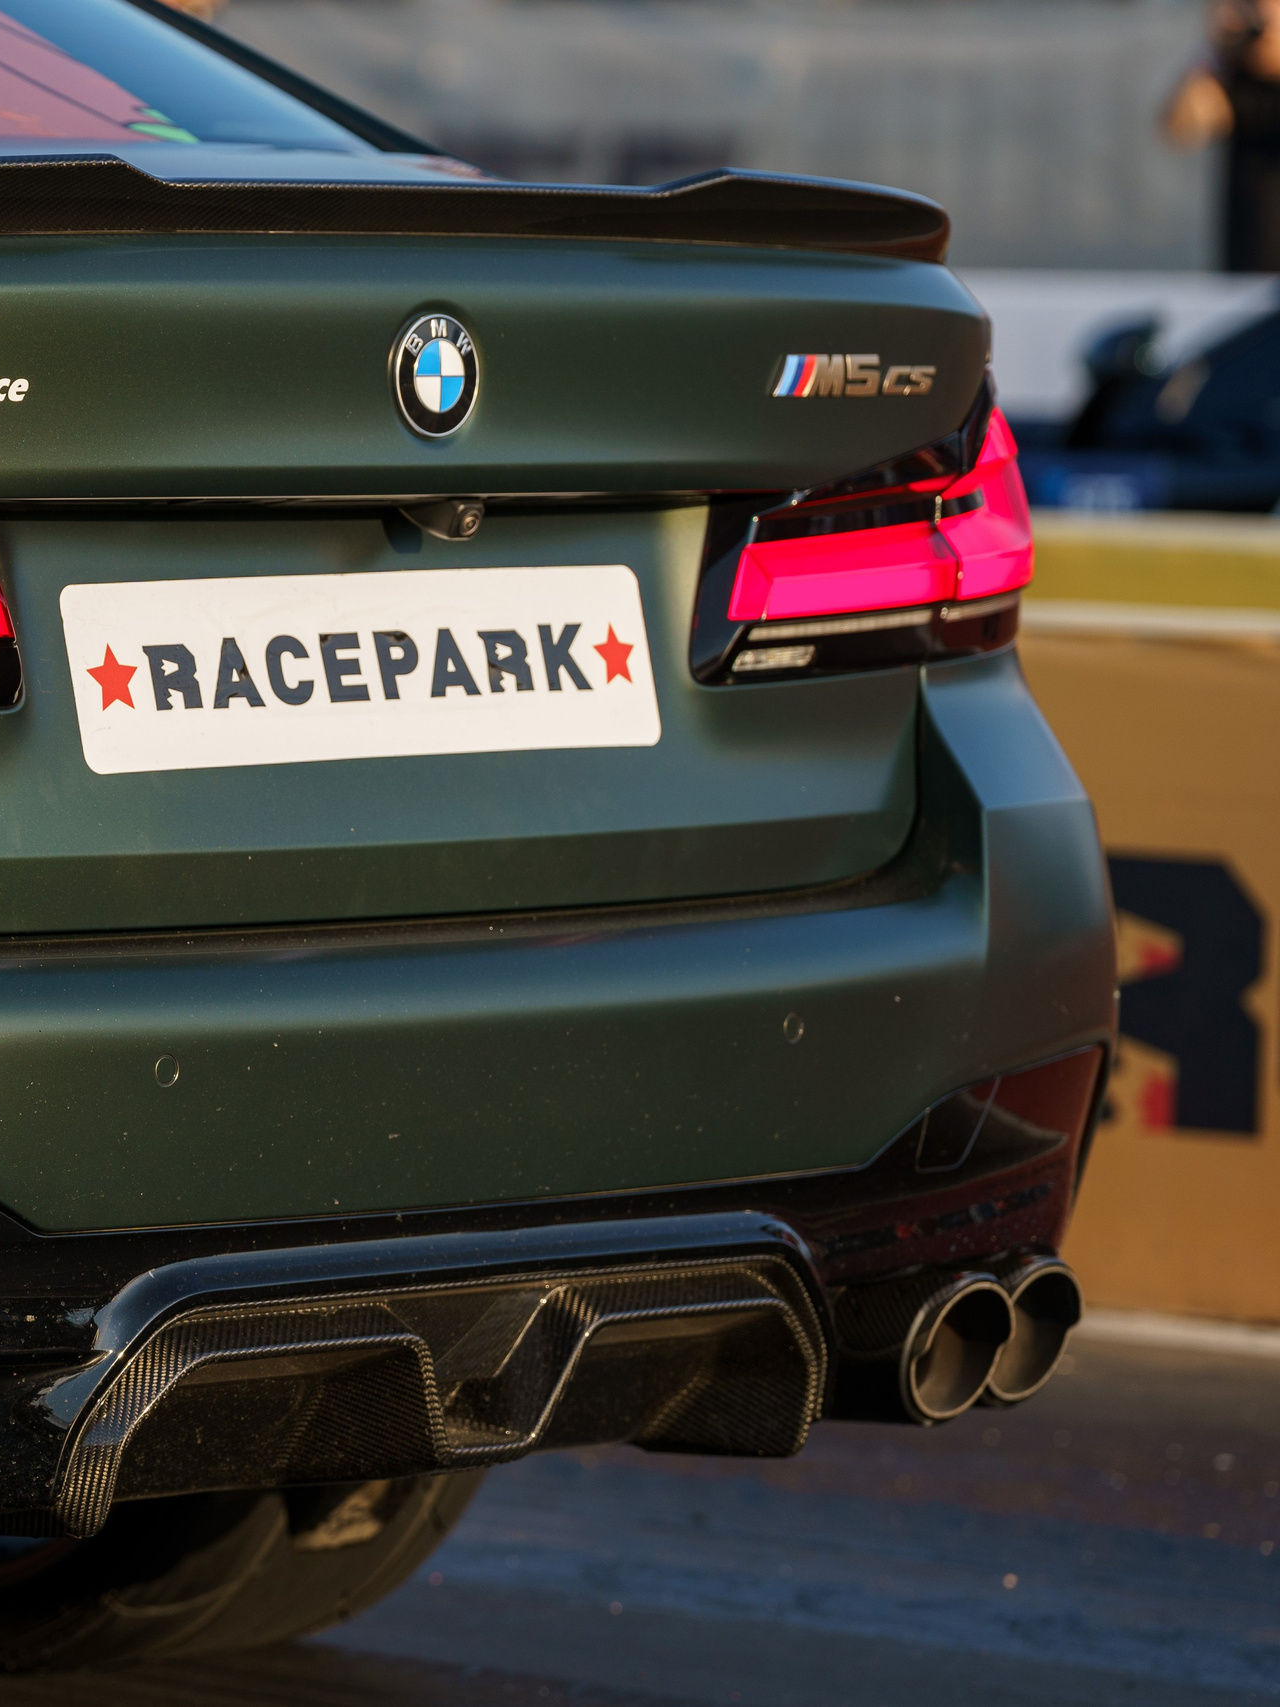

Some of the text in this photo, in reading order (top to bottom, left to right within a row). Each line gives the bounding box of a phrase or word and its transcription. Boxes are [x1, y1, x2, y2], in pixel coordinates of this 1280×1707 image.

[405, 318, 472, 357] BMW
[811, 354, 881, 397] M5
[142, 623, 593, 711] RACEPARK
